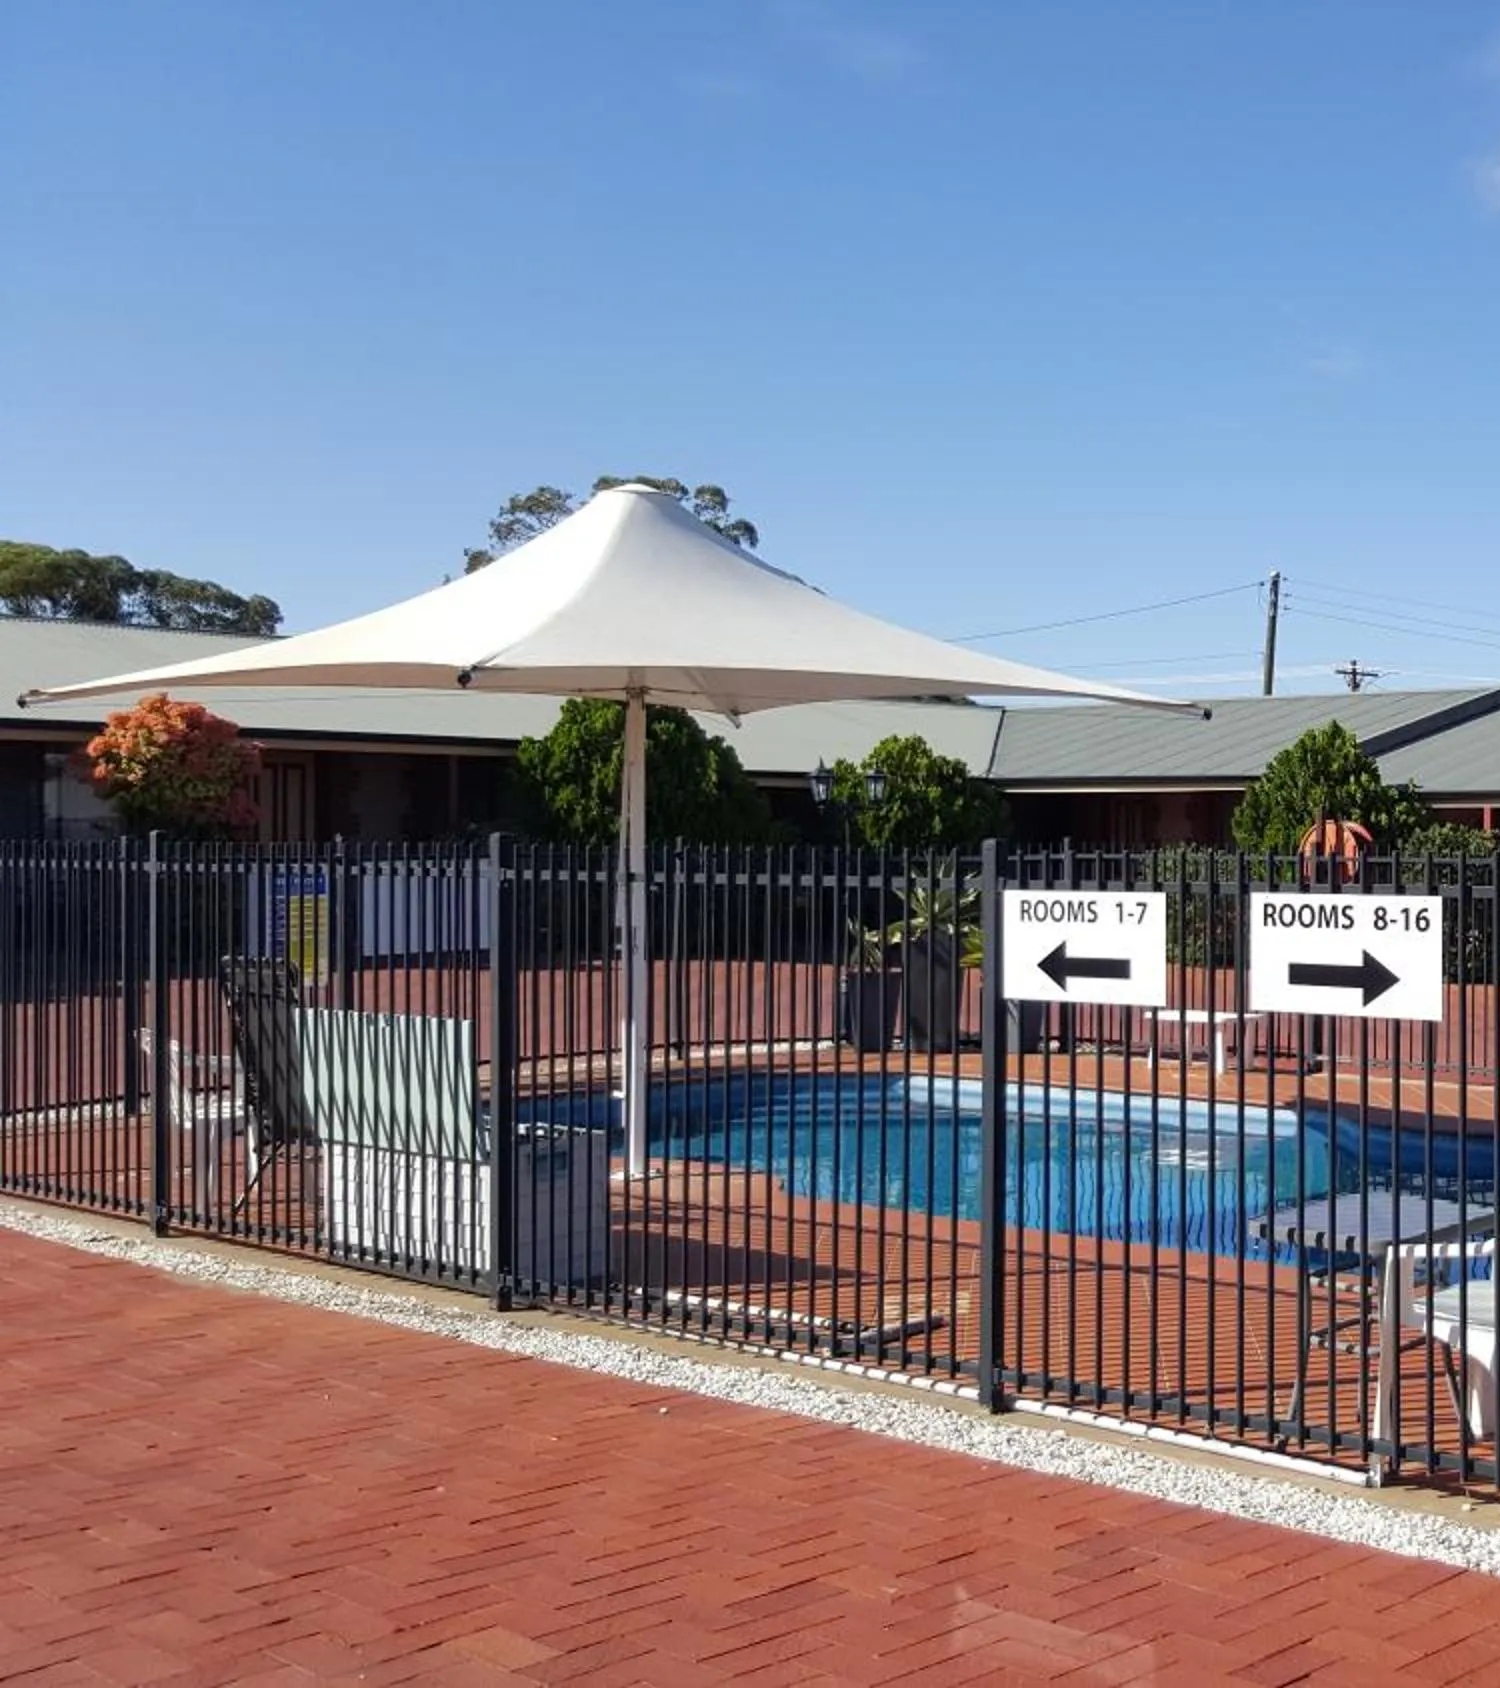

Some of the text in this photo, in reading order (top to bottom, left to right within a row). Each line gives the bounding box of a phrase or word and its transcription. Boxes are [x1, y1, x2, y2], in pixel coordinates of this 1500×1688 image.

[1020, 899, 1148, 925] ROOMS 1-7
[1263, 902, 1431, 933] ROOMS 8-16
